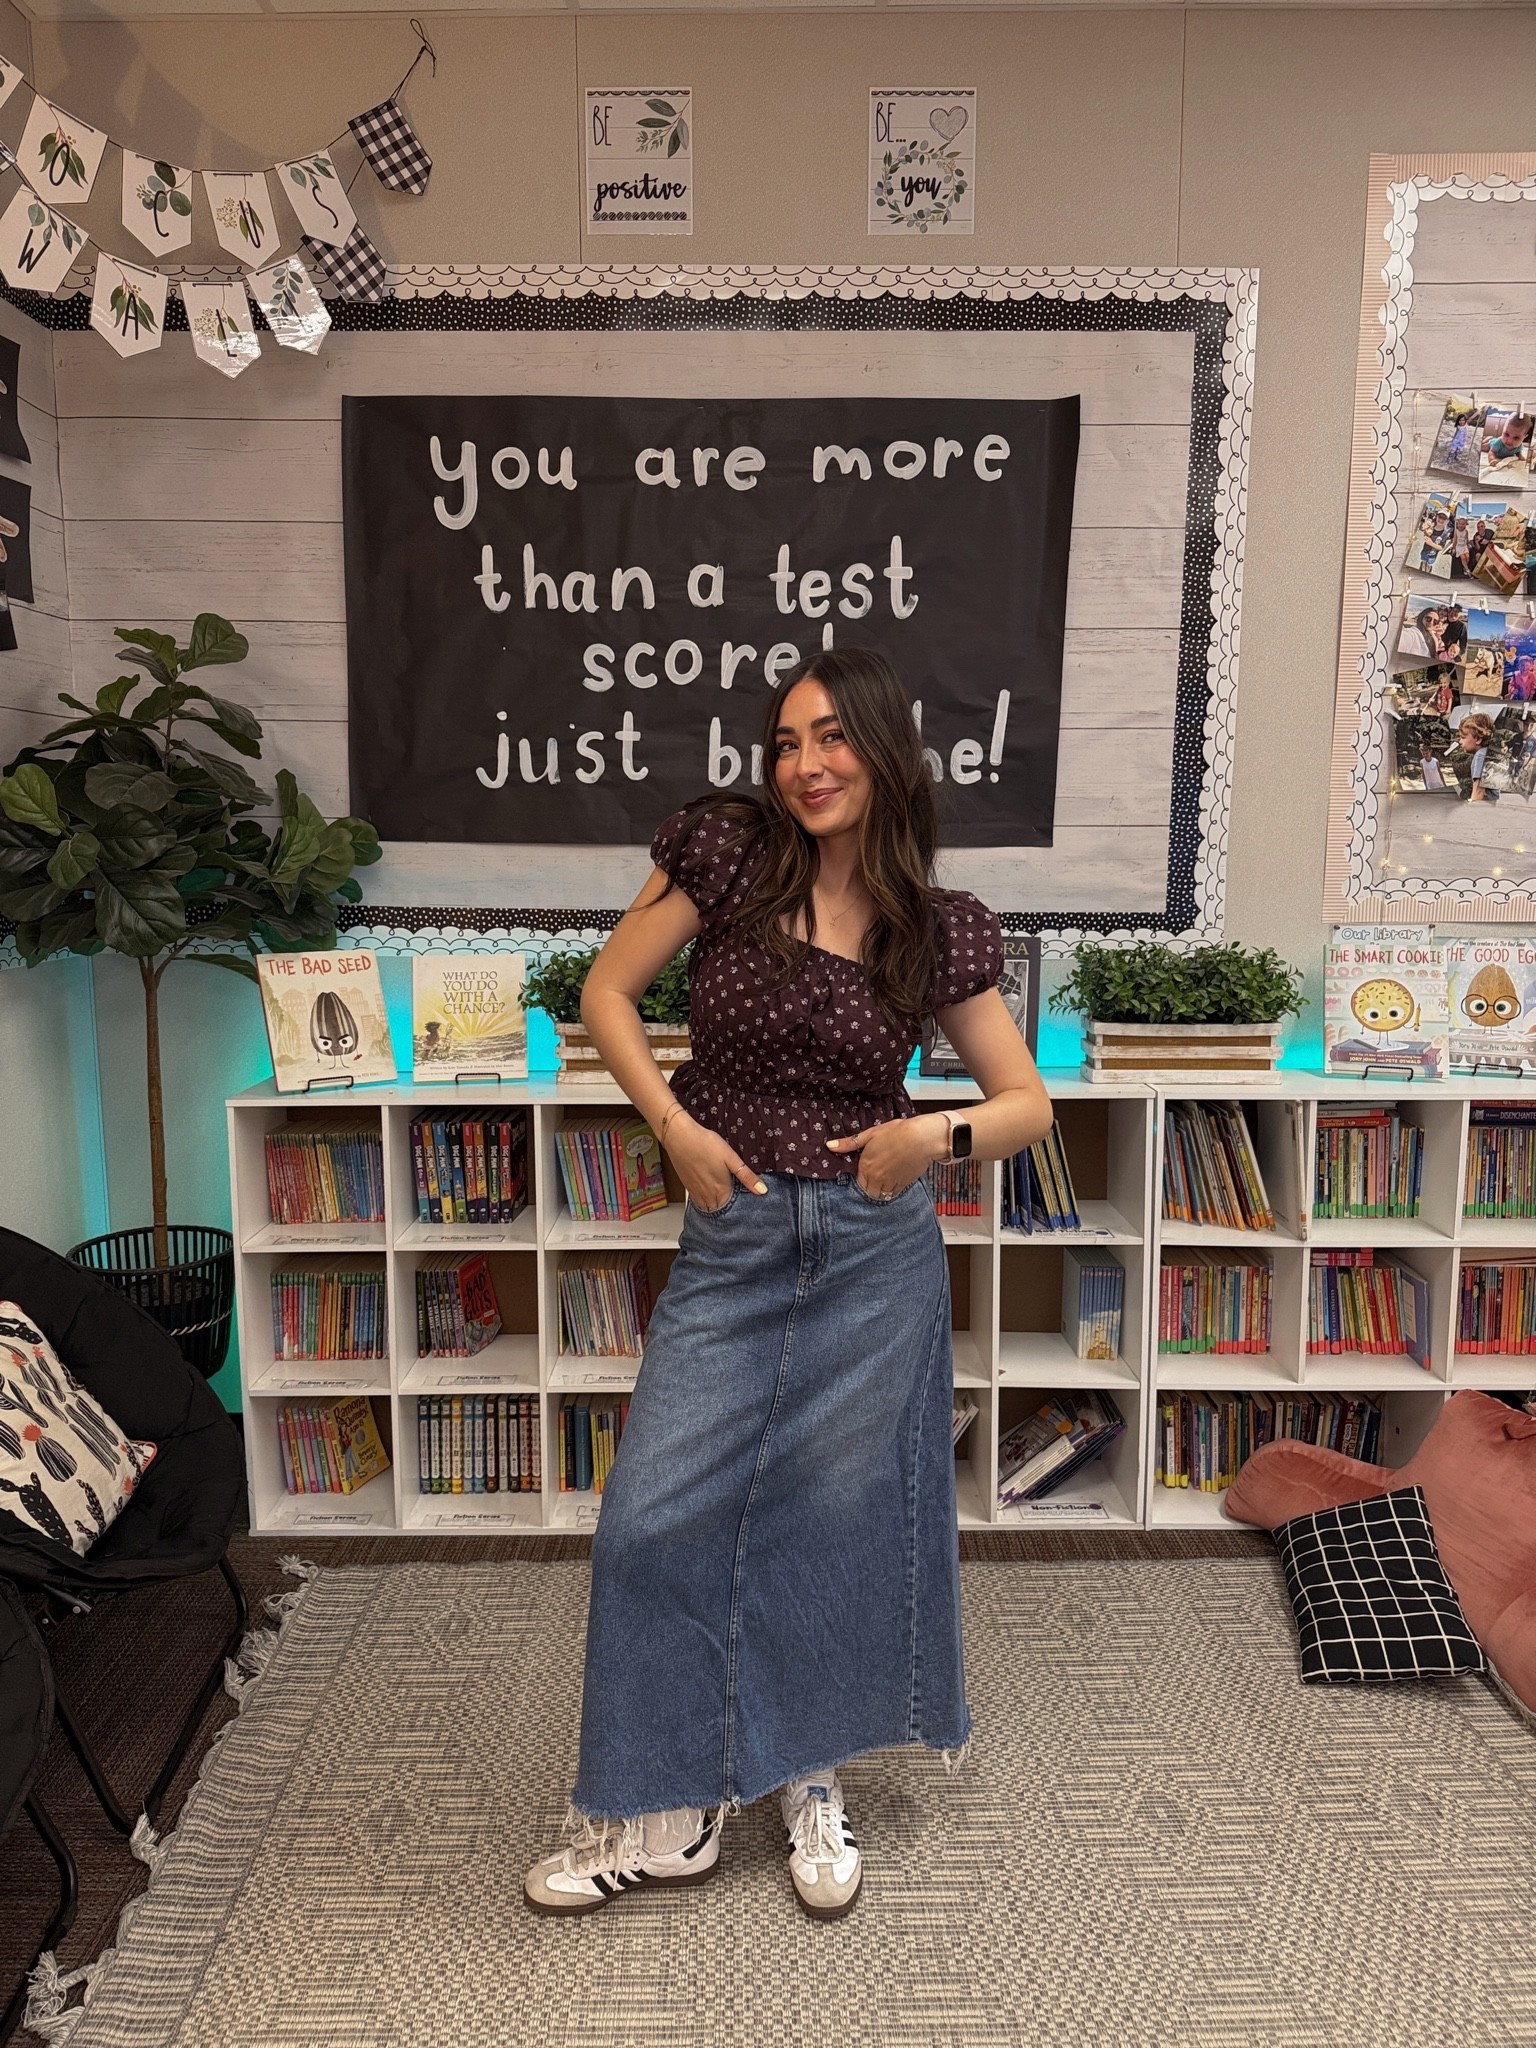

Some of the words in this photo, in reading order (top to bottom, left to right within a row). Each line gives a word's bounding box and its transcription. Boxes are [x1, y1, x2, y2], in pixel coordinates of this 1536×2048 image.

[593, 104, 612, 147] BE
[593, 173, 687, 212] positive
[900, 174, 942, 208] you
[430, 435, 578, 530] you
[635, 445, 766, 491] are
[813, 434, 1011, 483] more
[473, 543, 656, 613] than
[686, 562, 725, 609] a
[767, 535, 919, 619] test
[475, 710, 649, 789] just
[1341, 927, 1371, 941] Our
[265, 959, 296, 976] THE
[302, 957, 332, 976] BAD
[338, 954, 372, 975] SEED
[1329, 948, 1350, 963] THE
[1354, 948, 1393, 964] SMART
[1397, 949, 1443, 965] COOKIE
[1474, 948, 1510, 963] GOOD
[1517, 949, 1536, 965] EG
[442, 971, 478, 980] WHAT
[480, 970, 498, 980] DO
[443, 980, 473, 991] YOU
[476, 980, 498, 990] DO
[443, 991, 485, 1003] WITH
[487, 990, 498, 1002] A
[443, 1001, 506, 1014] CHANCE?
